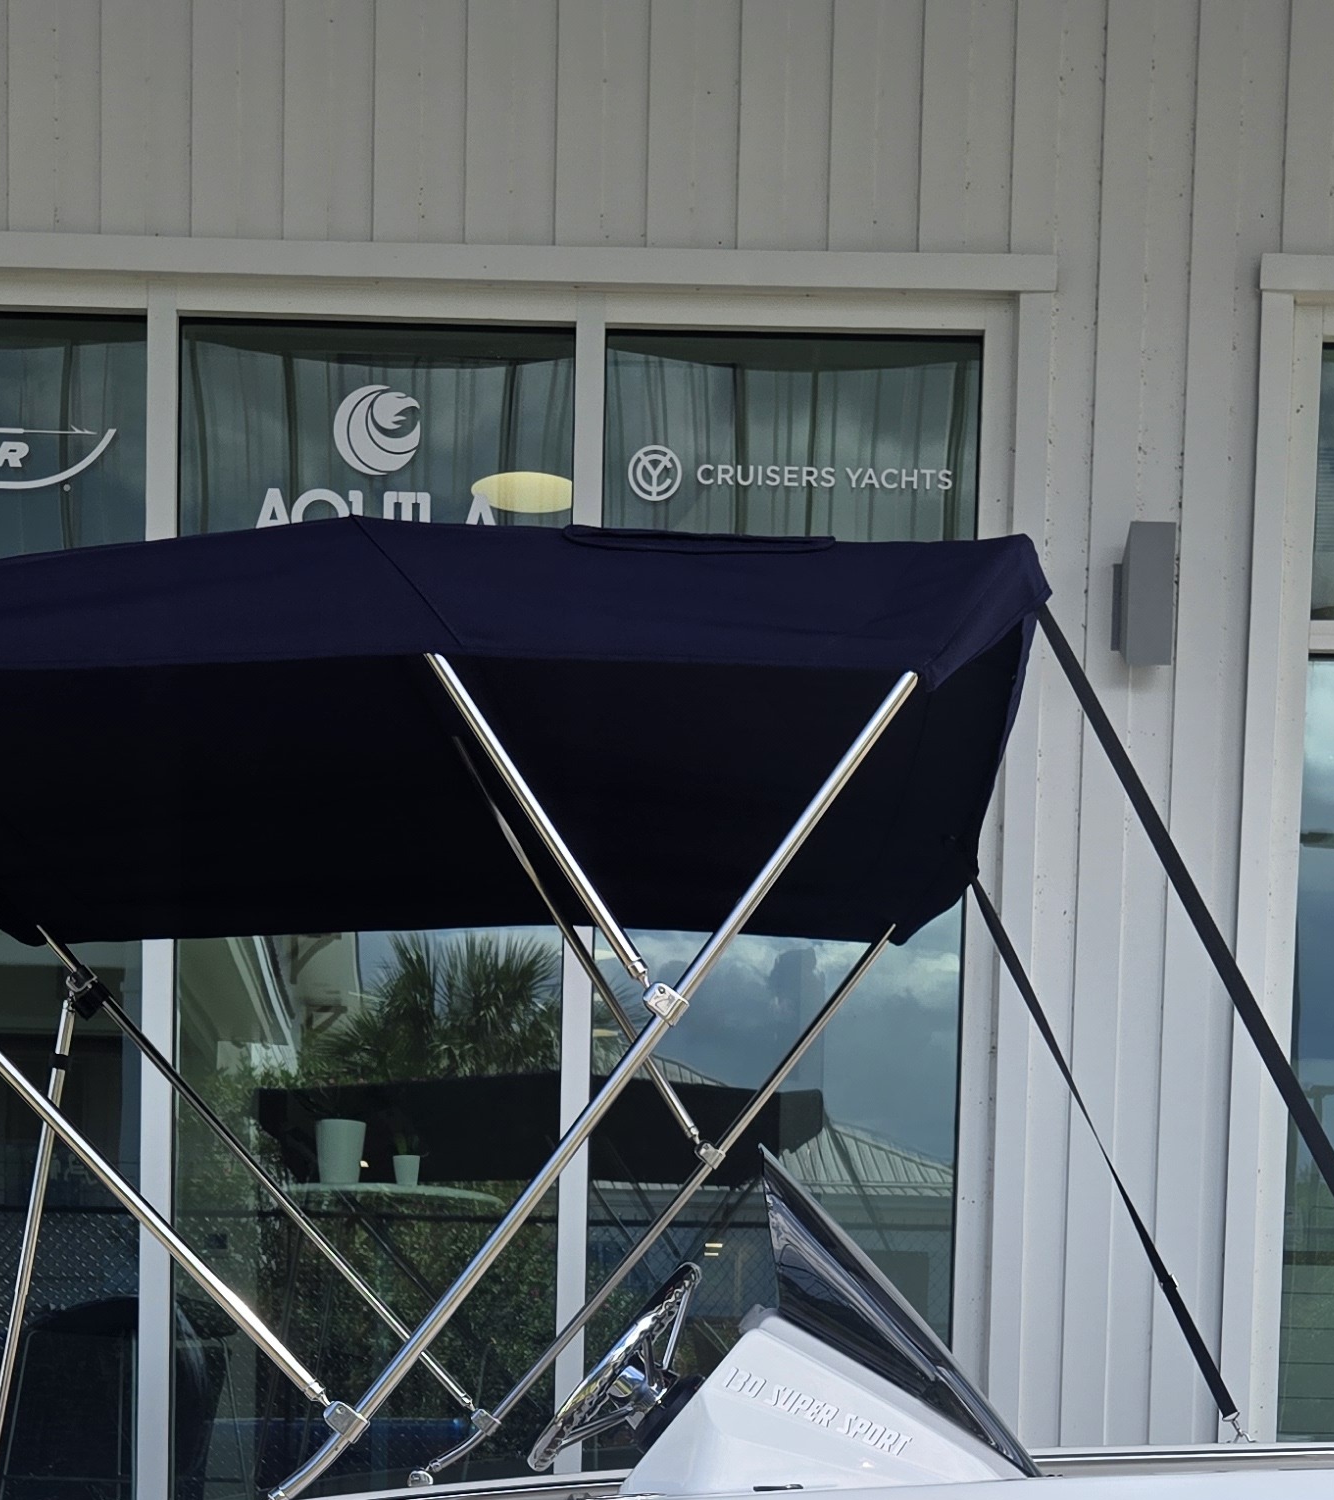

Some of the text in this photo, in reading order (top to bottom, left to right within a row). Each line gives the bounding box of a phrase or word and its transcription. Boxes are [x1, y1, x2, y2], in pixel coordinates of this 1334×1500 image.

[696, 463, 954, 491] CRUISERS YACHTS
[723, 1366, 913, 1456] 130 SUPER SPORT
